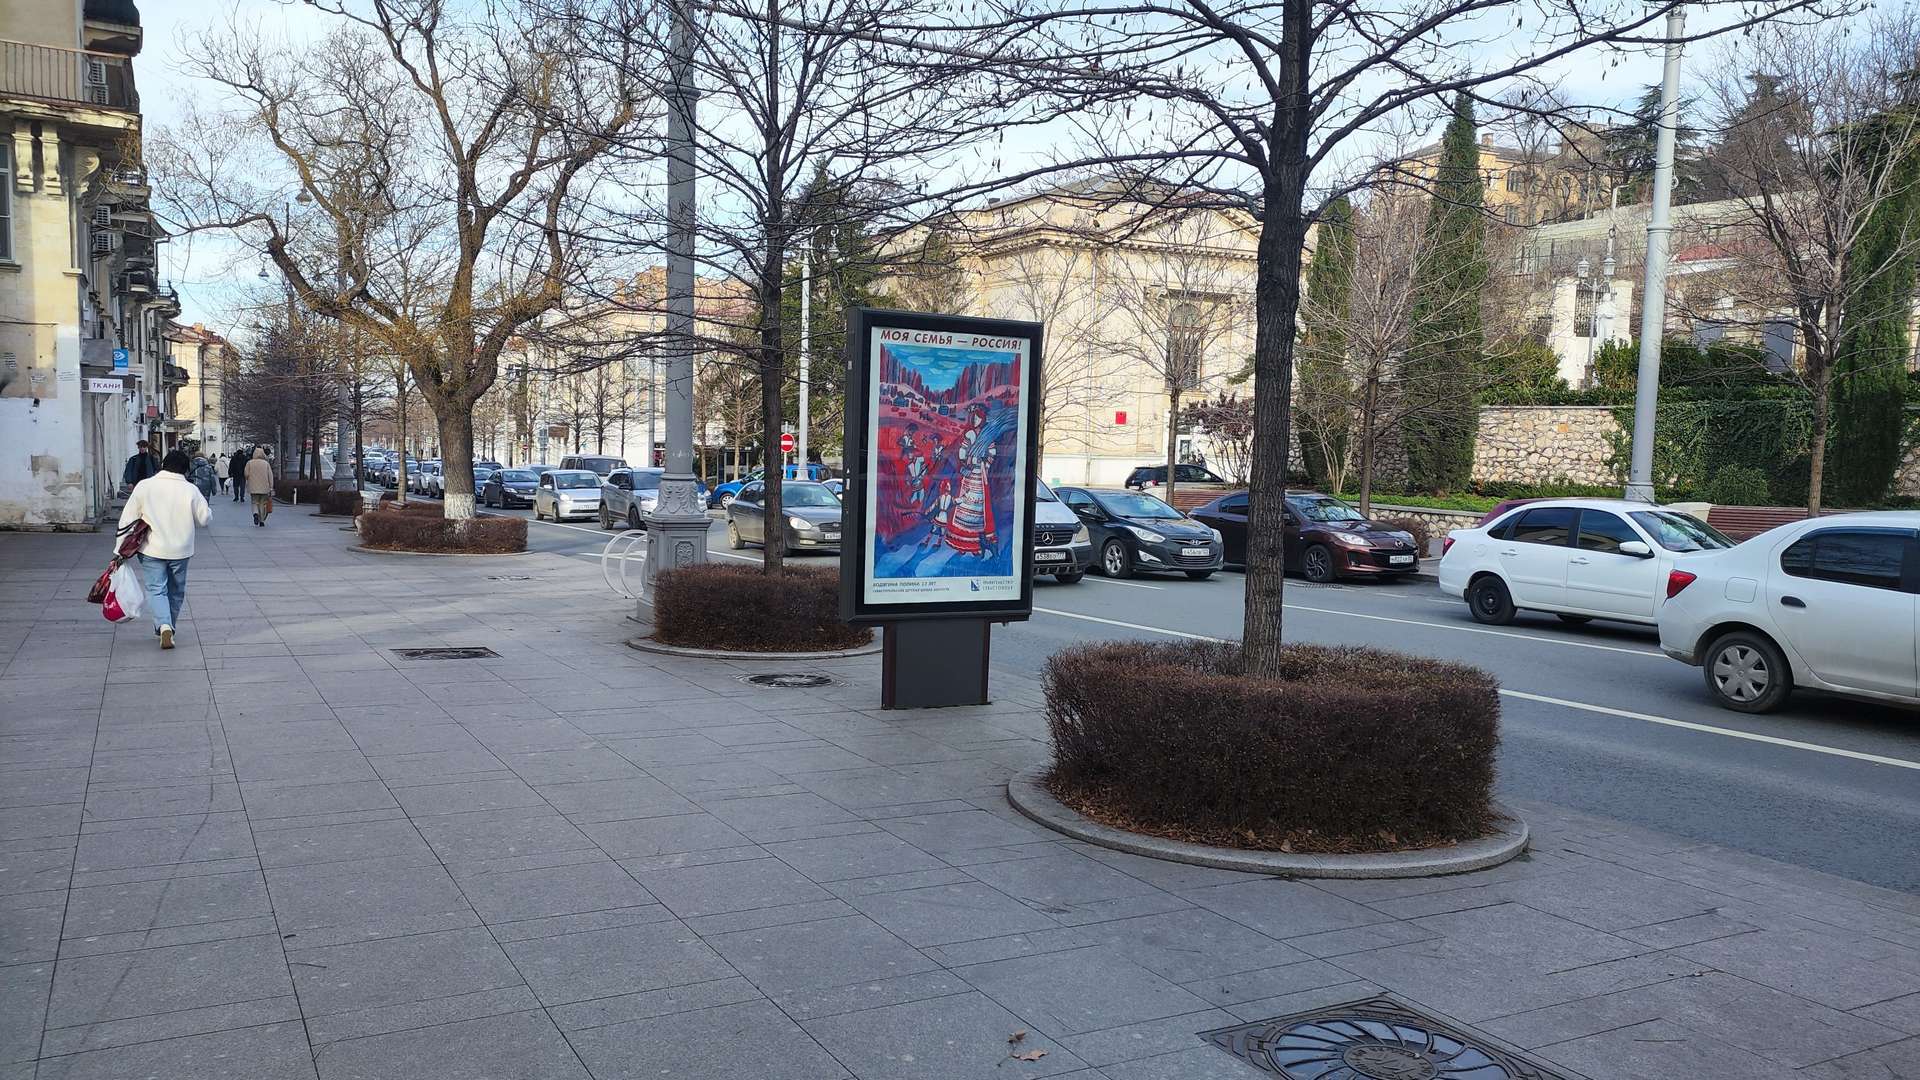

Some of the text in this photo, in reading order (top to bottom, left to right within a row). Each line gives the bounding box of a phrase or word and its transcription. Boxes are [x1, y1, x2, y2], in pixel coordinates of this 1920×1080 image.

[880, 330, 909, 341] МОЯ
[914, 333, 953, 345] СЕМЬЯ
[972, 337, 1022, 350] РОССИЯ!
[92, 382, 121, 390] ТКАНИ
